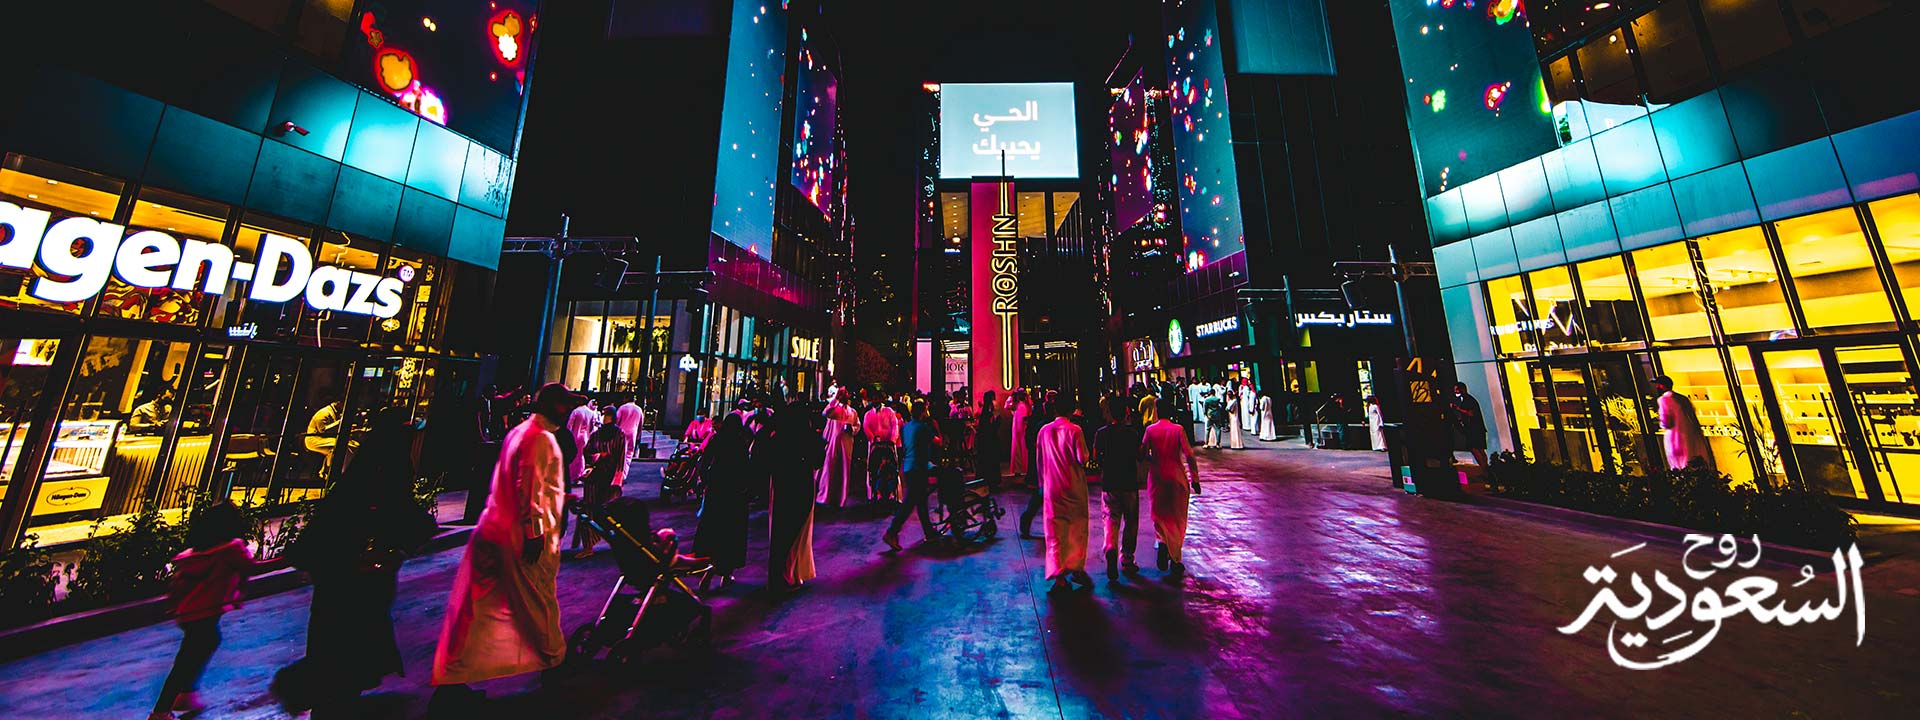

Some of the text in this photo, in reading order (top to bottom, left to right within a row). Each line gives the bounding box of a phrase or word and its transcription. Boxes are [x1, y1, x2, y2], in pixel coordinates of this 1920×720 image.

[972, 100, 1039, 132] الحي
[972, 134, 1040, 160] يحييك
[991, 215, 1019, 314] ROSHN
[1195, 315, 1238, 338] STARBUCKS
[1294, 310, 1393, 328] ستاربكس
